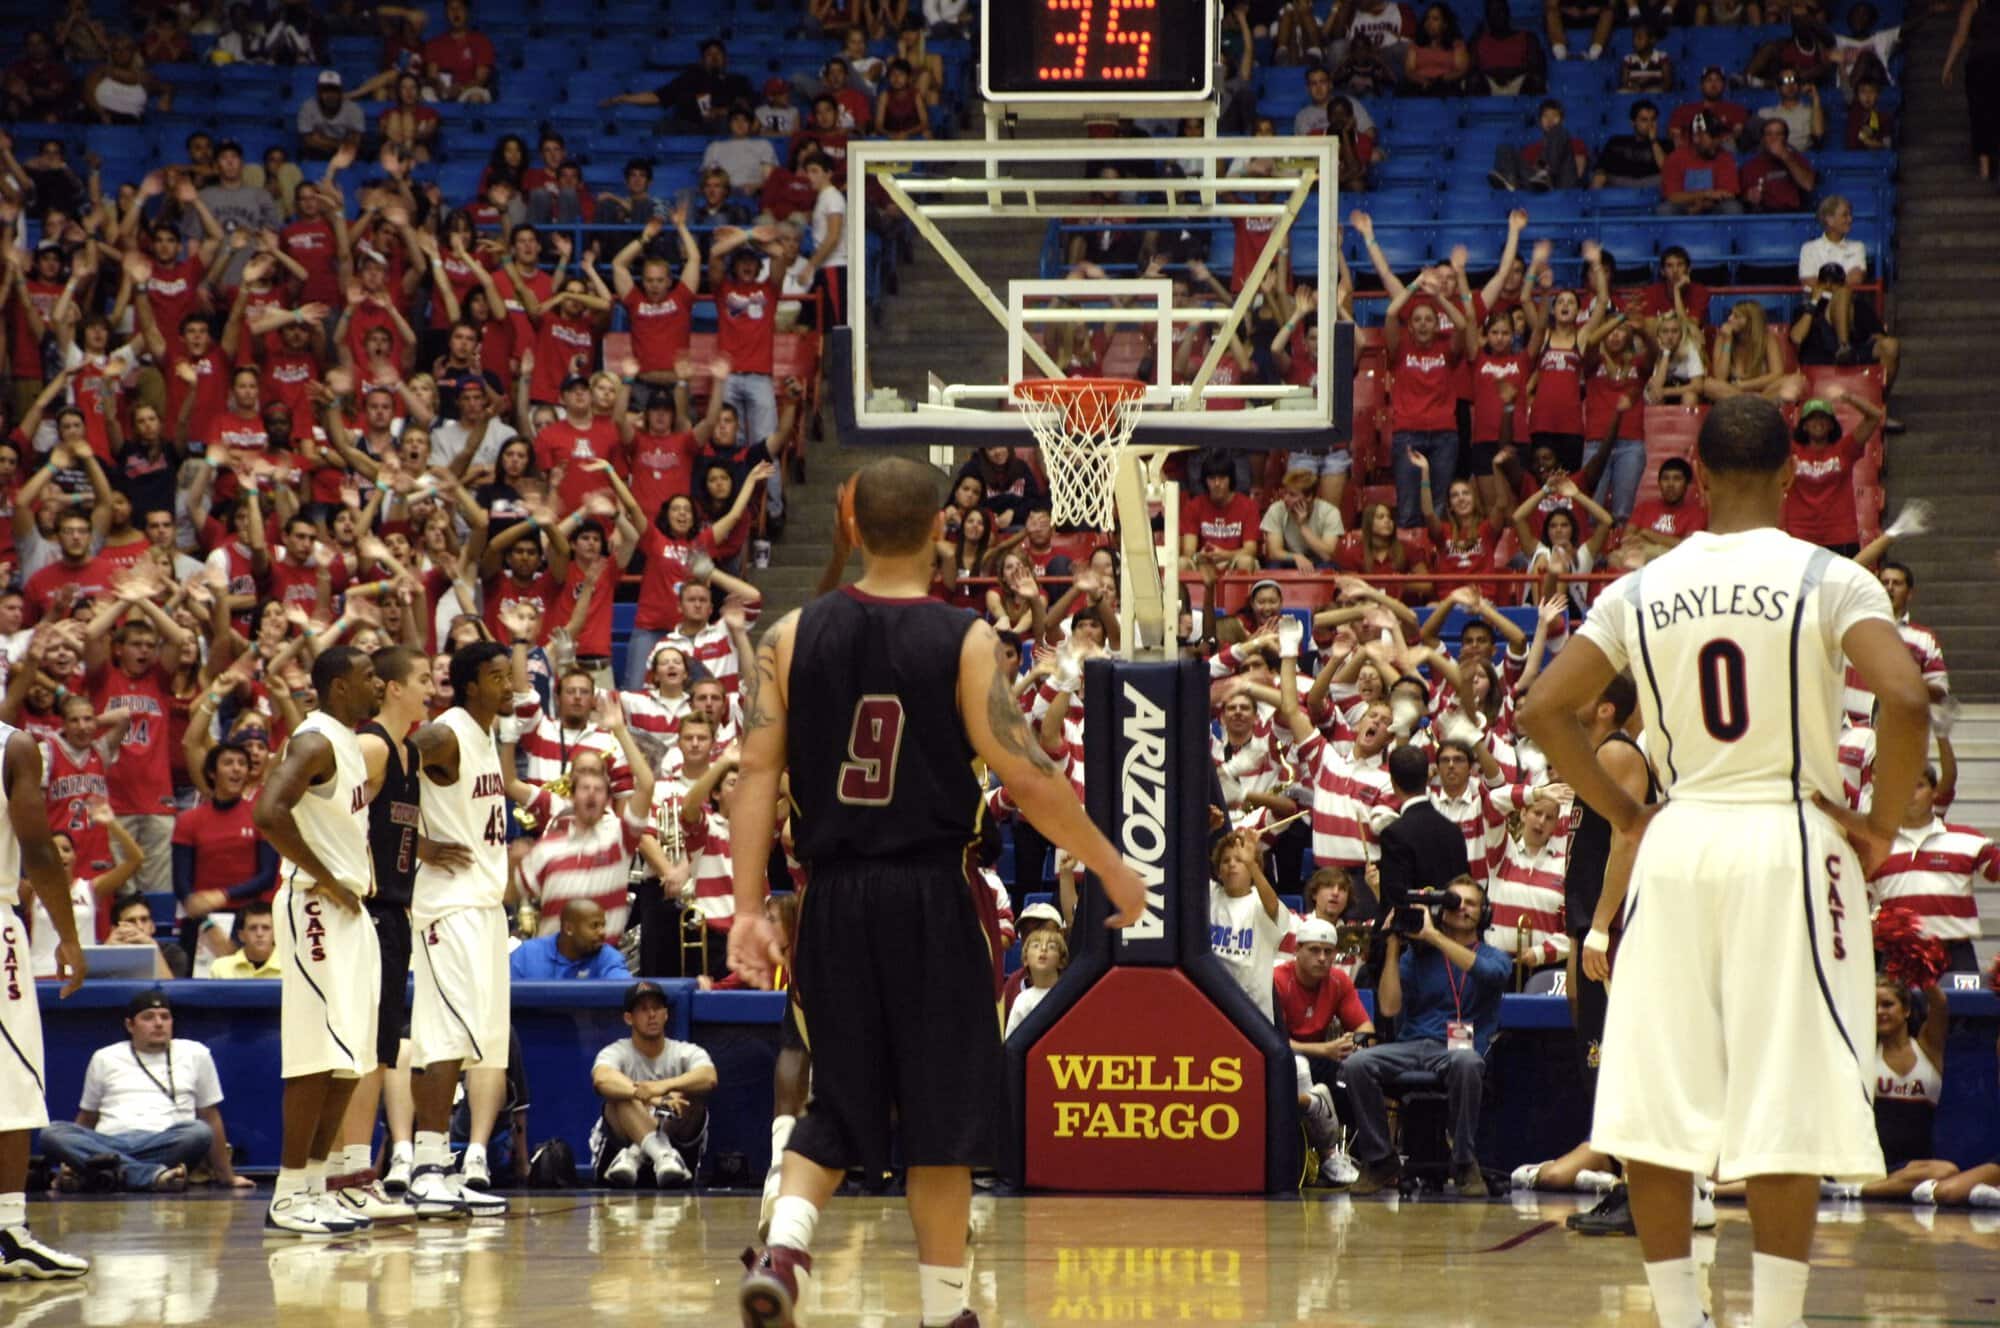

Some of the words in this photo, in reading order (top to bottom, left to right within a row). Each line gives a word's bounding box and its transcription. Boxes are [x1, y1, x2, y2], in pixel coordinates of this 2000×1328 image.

[1039, 0, 1156, 80] 35
[1649, 584, 1789, 630] BAYLESS
[1698, 637, 1750, 743] 0
[837, 694, 906, 806] 9
[1122, 680, 1167, 939] ARIZONA
[304, 901, 326, 962] CATS
[1825, 854, 1847, 961] CATS
[3, 926, 22, 1001] CATS
[1047, 1054, 1243, 1093] WELLS
[1877, 1076, 1893, 1094] U
[1911, 1079, 1926, 1095] A
[1053, 1102, 1240, 1140] FARGO
